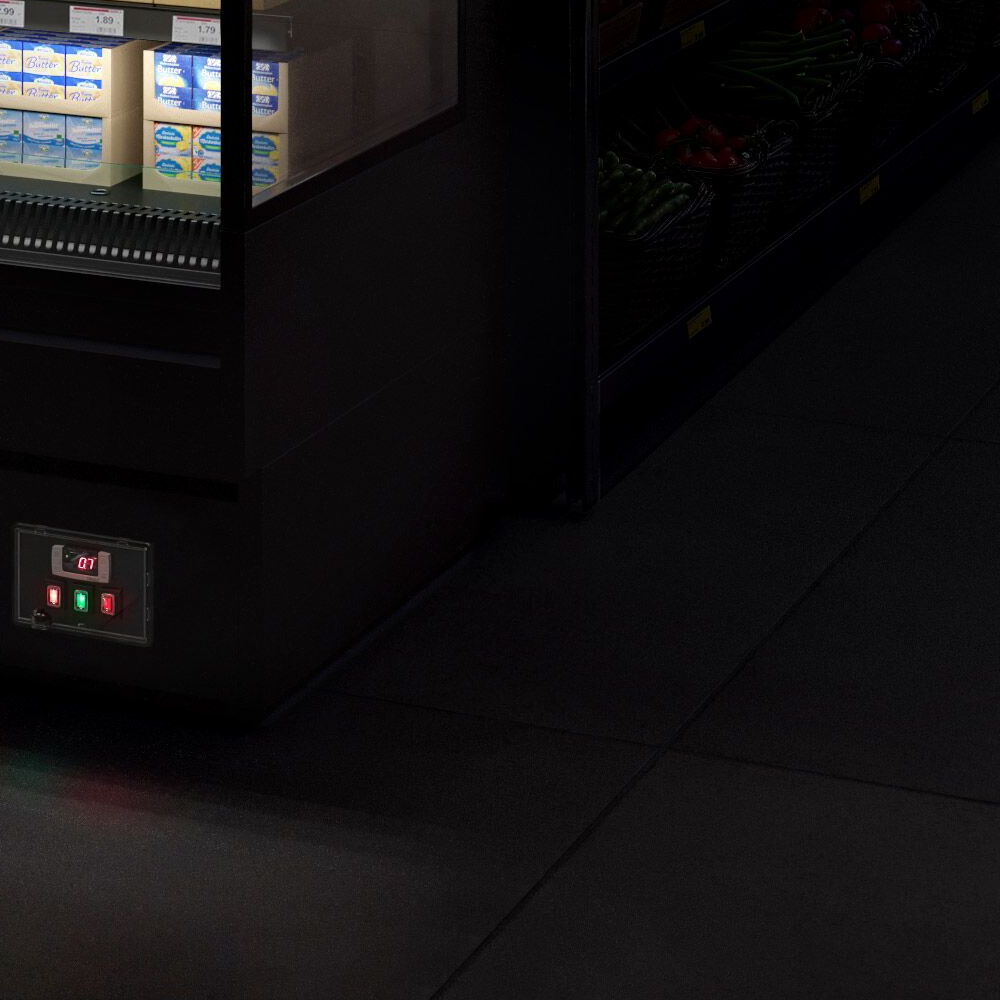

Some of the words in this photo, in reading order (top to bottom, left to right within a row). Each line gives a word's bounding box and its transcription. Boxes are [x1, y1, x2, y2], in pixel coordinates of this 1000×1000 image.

[96, 16, 114, 24] 1.89
[198, 26, 216, 34] 1.79
[26, 57, 58, 69] Butter
[70, 60, 102, 73] Butter
[158, 64, 182, 74] Butter
[202, 68, 221, 78] Butt
[158, 96, 182, 108] Butter
[202, 101, 221, 111] Butt
